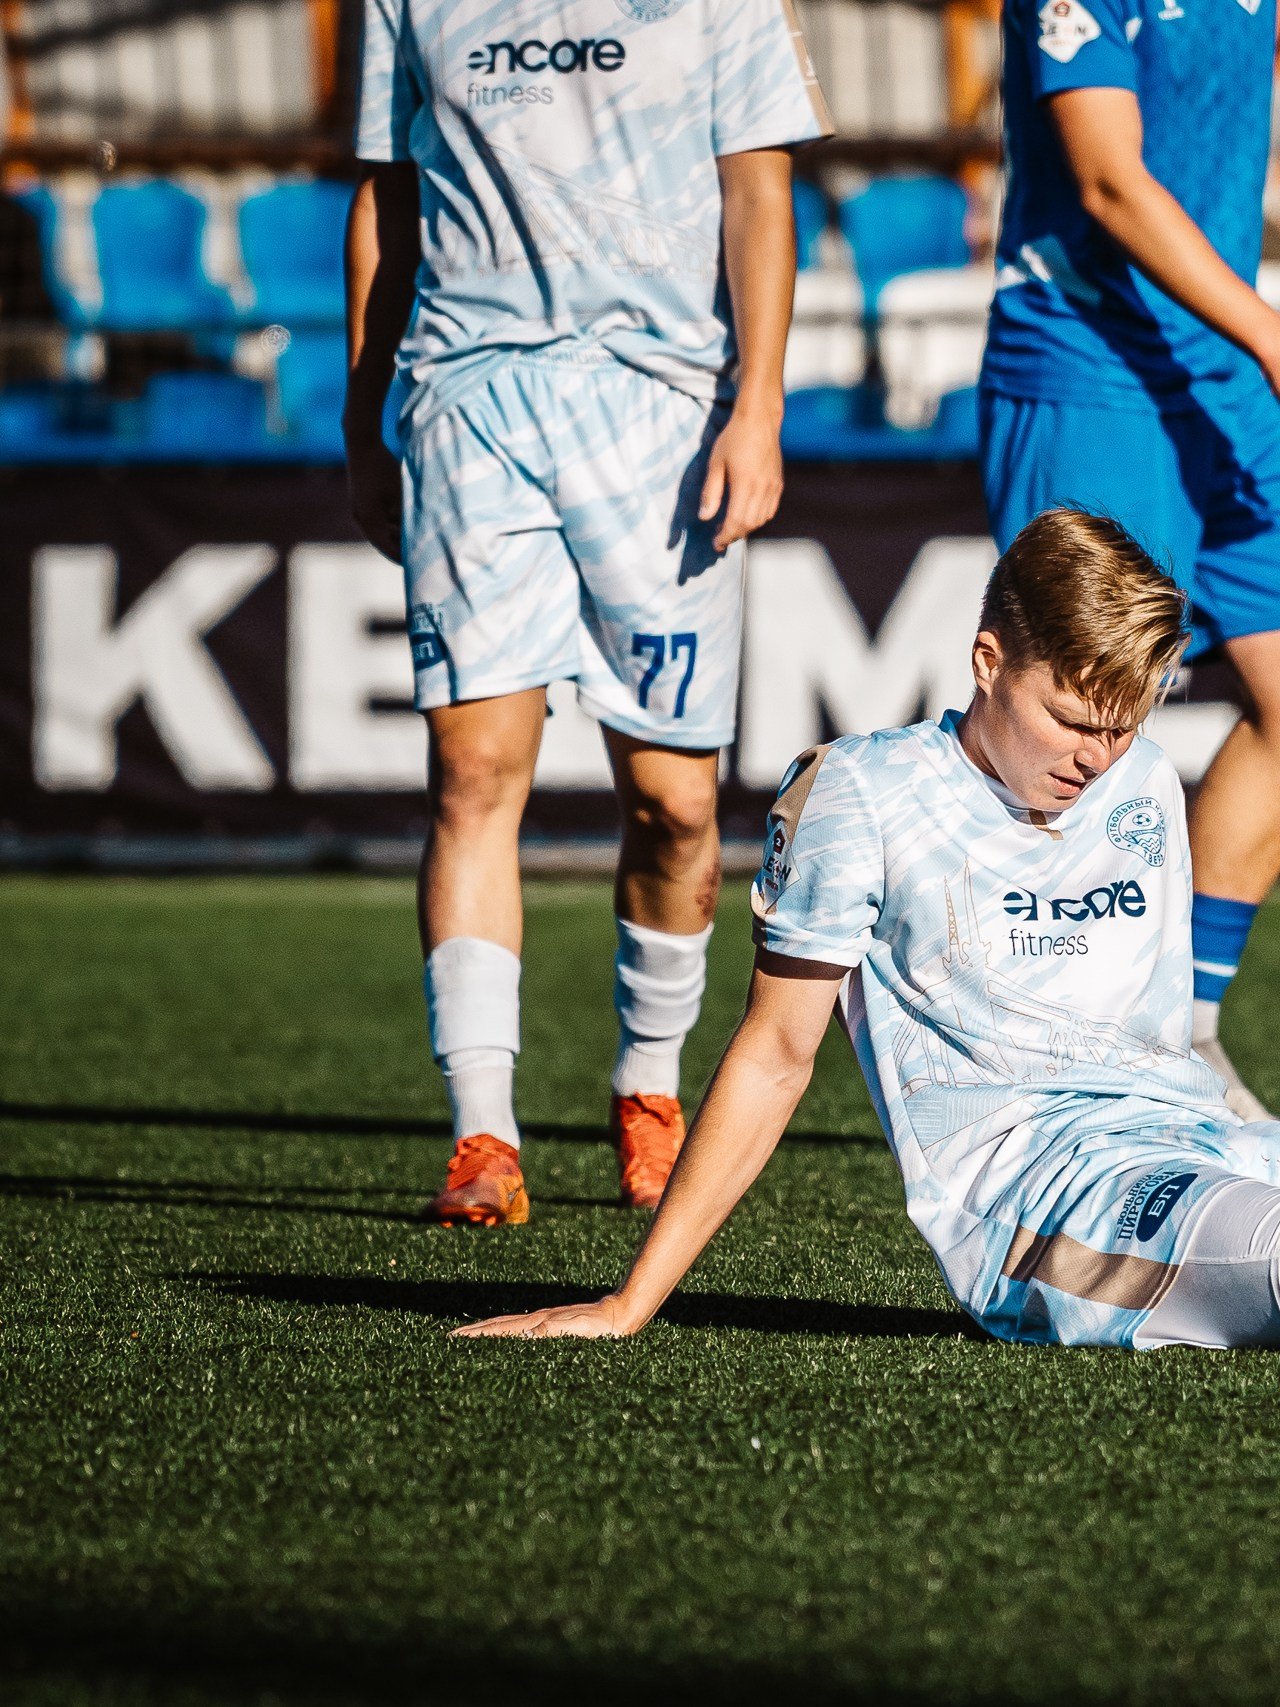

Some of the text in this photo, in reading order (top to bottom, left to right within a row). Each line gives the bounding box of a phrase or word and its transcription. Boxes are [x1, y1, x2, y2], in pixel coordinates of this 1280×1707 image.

[467, 38, 626, 75] encore
[466, 82, 555, 108] fitness
[32, 541, 1243, 791] KEM
[631, 632, 698, 719] 77
[1009, 928, 1090, 957] fitness
[1117, 1171, 1184, 1241] ПИРОГОВА
[1147, 1184, 1181, 1218] БП
